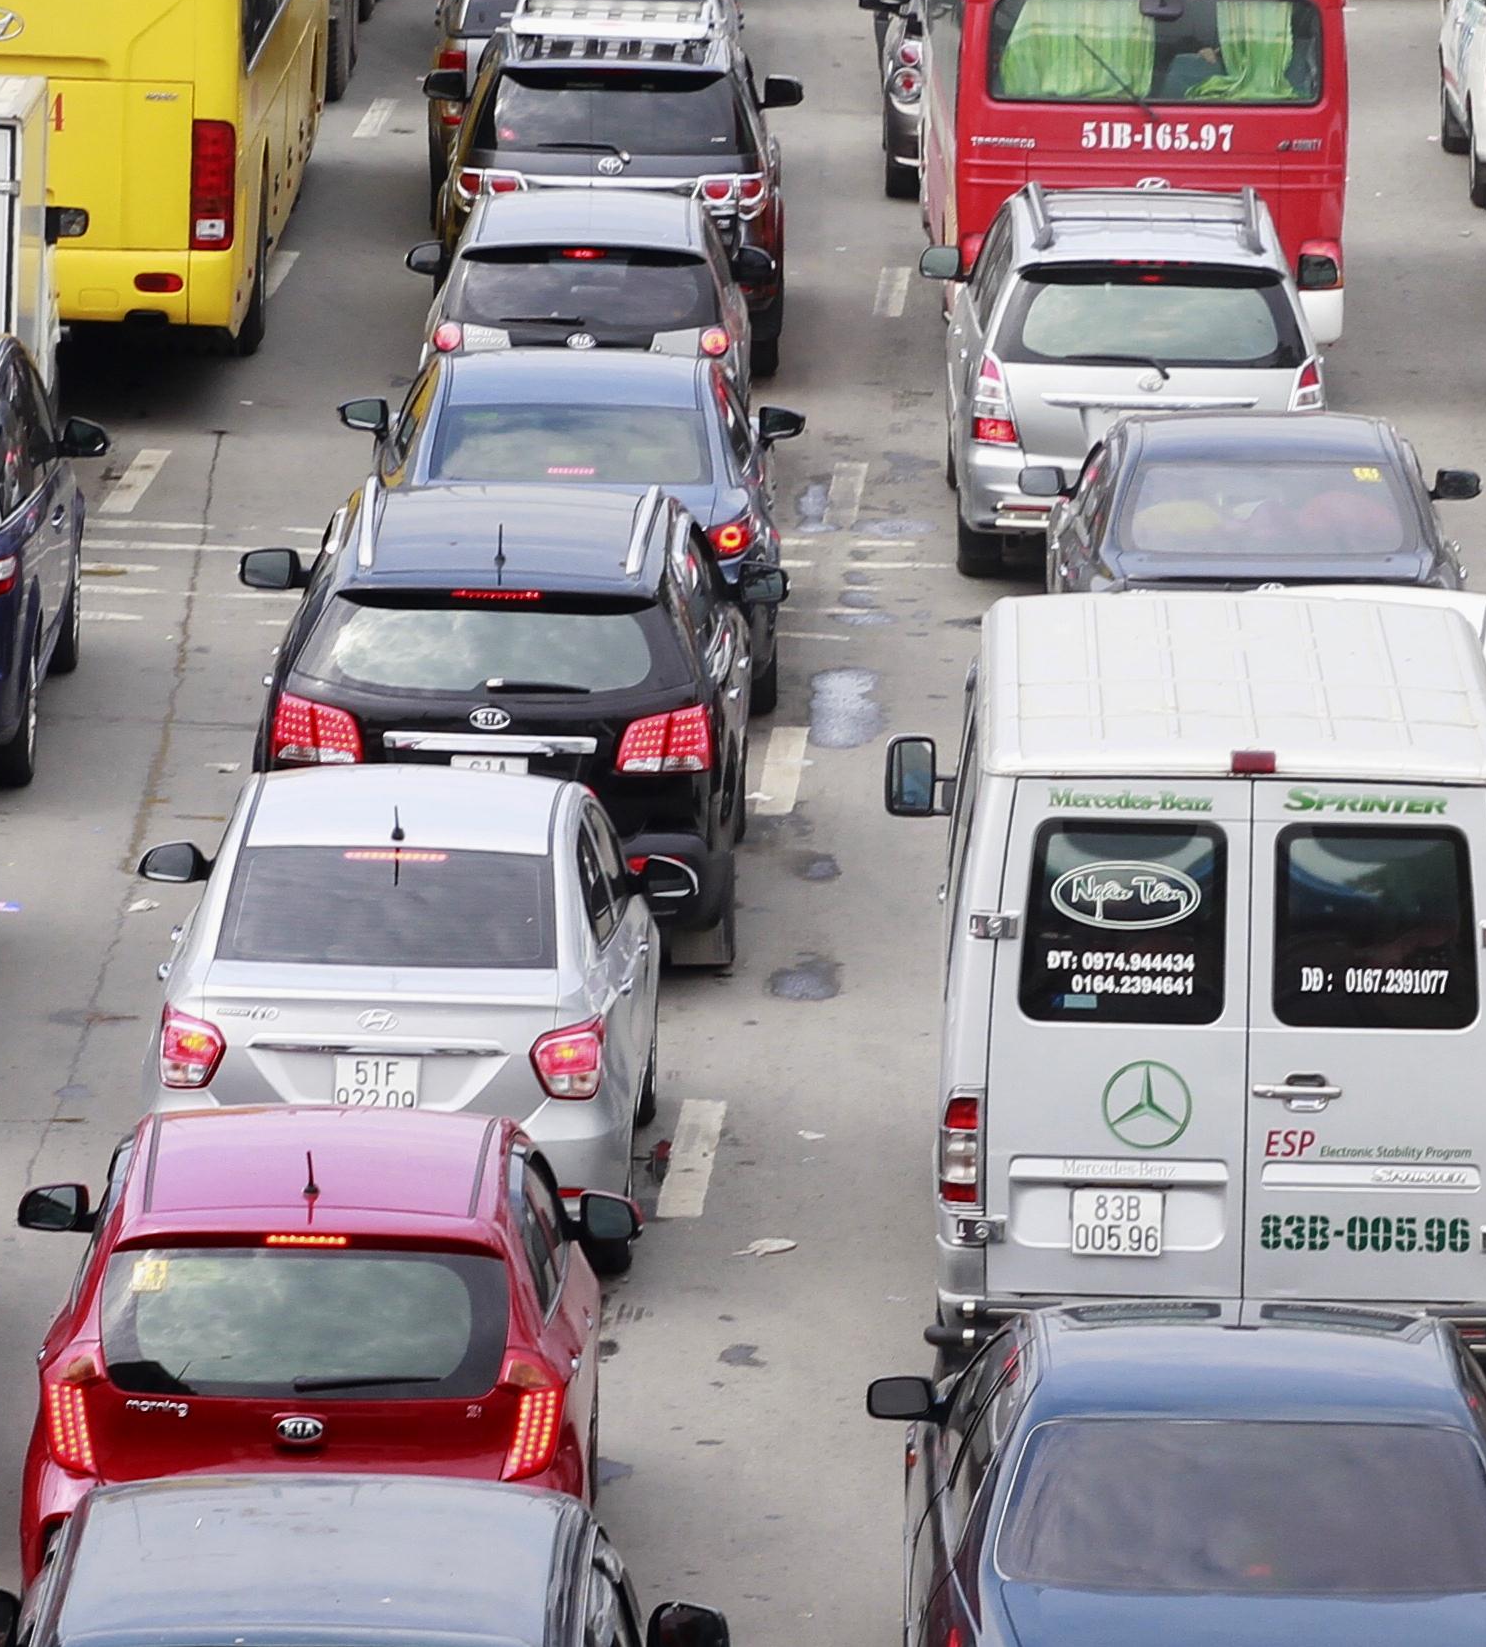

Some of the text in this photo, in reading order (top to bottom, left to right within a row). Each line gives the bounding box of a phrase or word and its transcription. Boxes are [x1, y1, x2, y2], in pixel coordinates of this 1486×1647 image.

[1081, 121, 1235, 153] 51B-165.97
[477, 712, 505, 725] KIA
[1048, 788, 1214, 812] Mercedes-Benz
[1047, 950, 1195, 973] ĐT: 0974.944434
[1071, 974, 1194, 996] 0164.2394641
[1344, 967, 1450, 995] 0167.2391077
[354, 1059, 401, 1087] 51F
[1265, 1130, 1473, 1162] ESP Electronic Stability Program
[1094, 1195, 1141, 1222] 83B
[1075, 1223, 1159, 1253] 005.96
[1261, 1213, 1471, 1253] 83B-005.96
[125, 1399, 189, 1418] morning
[282, 1420, 316, 1436] KIA
